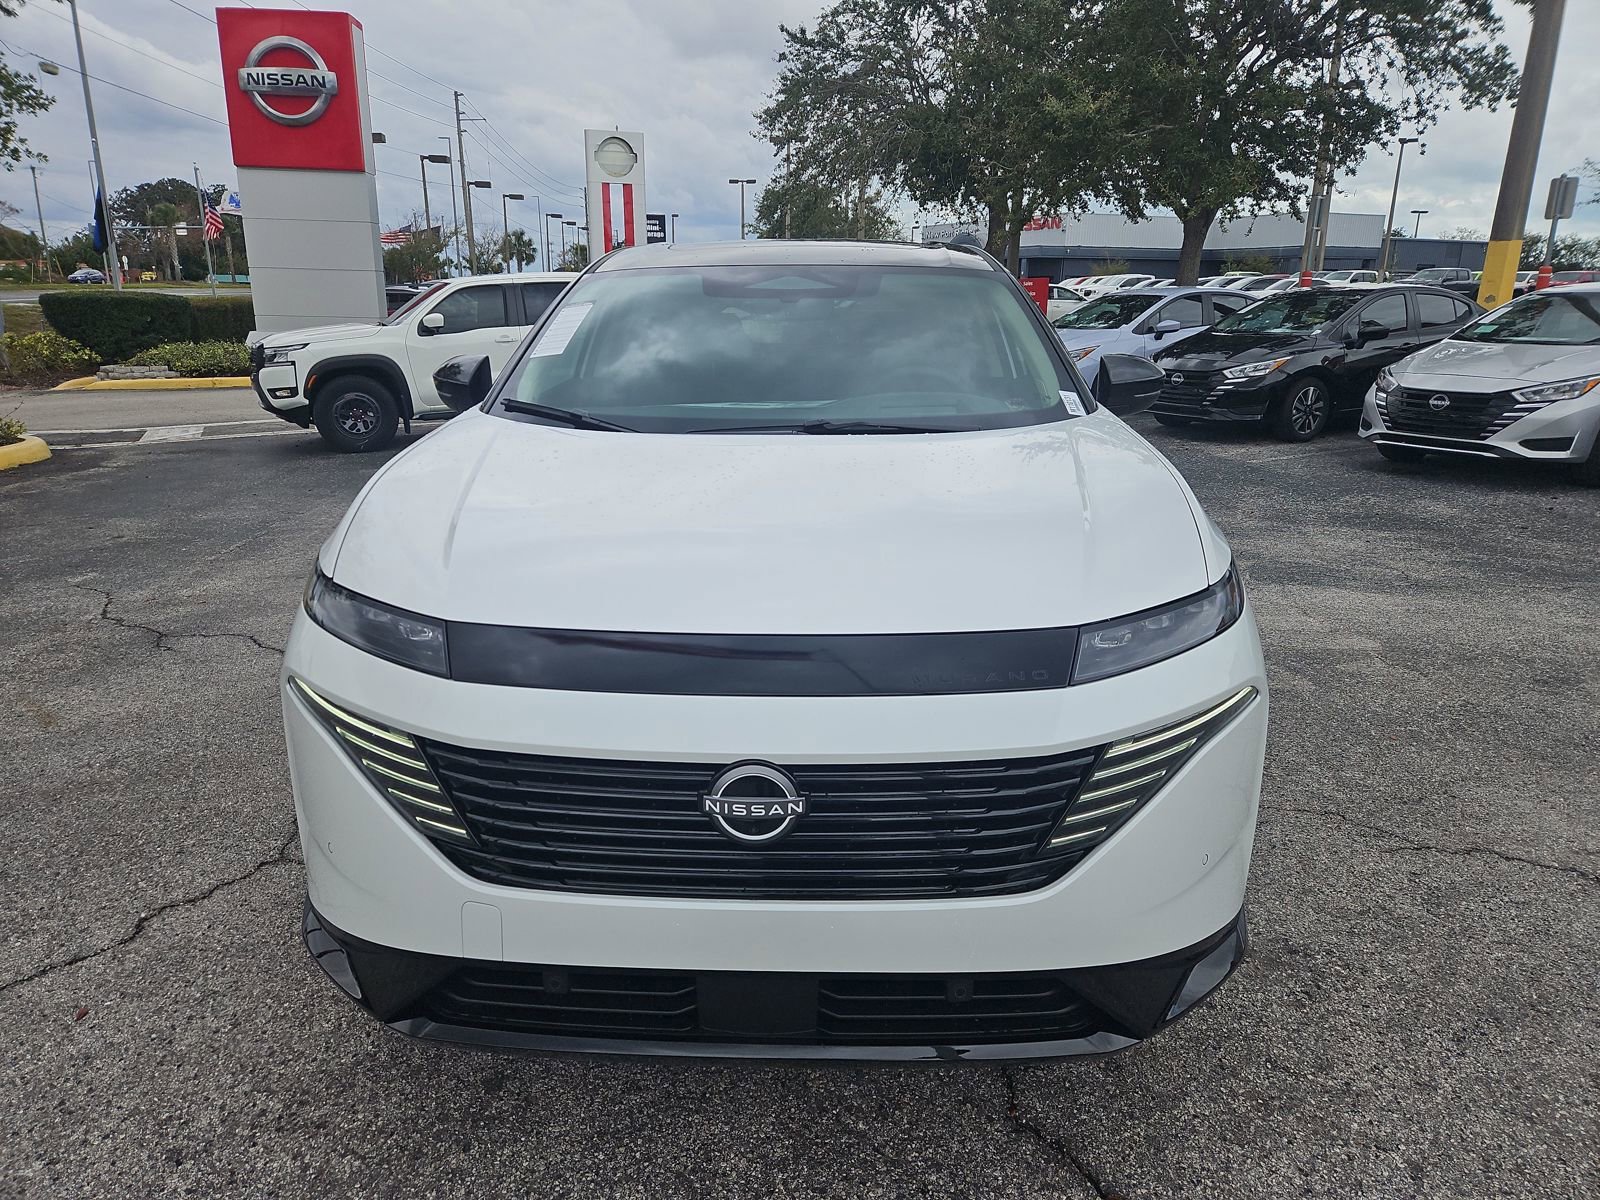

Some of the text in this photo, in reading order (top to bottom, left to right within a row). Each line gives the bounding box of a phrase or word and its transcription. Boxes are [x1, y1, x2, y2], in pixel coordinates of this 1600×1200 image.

[246, 72, 327, 88] NISSAN
[1023, 216, 1062, 231] SSAN
[705, 799, 803, 816] NISSAN
